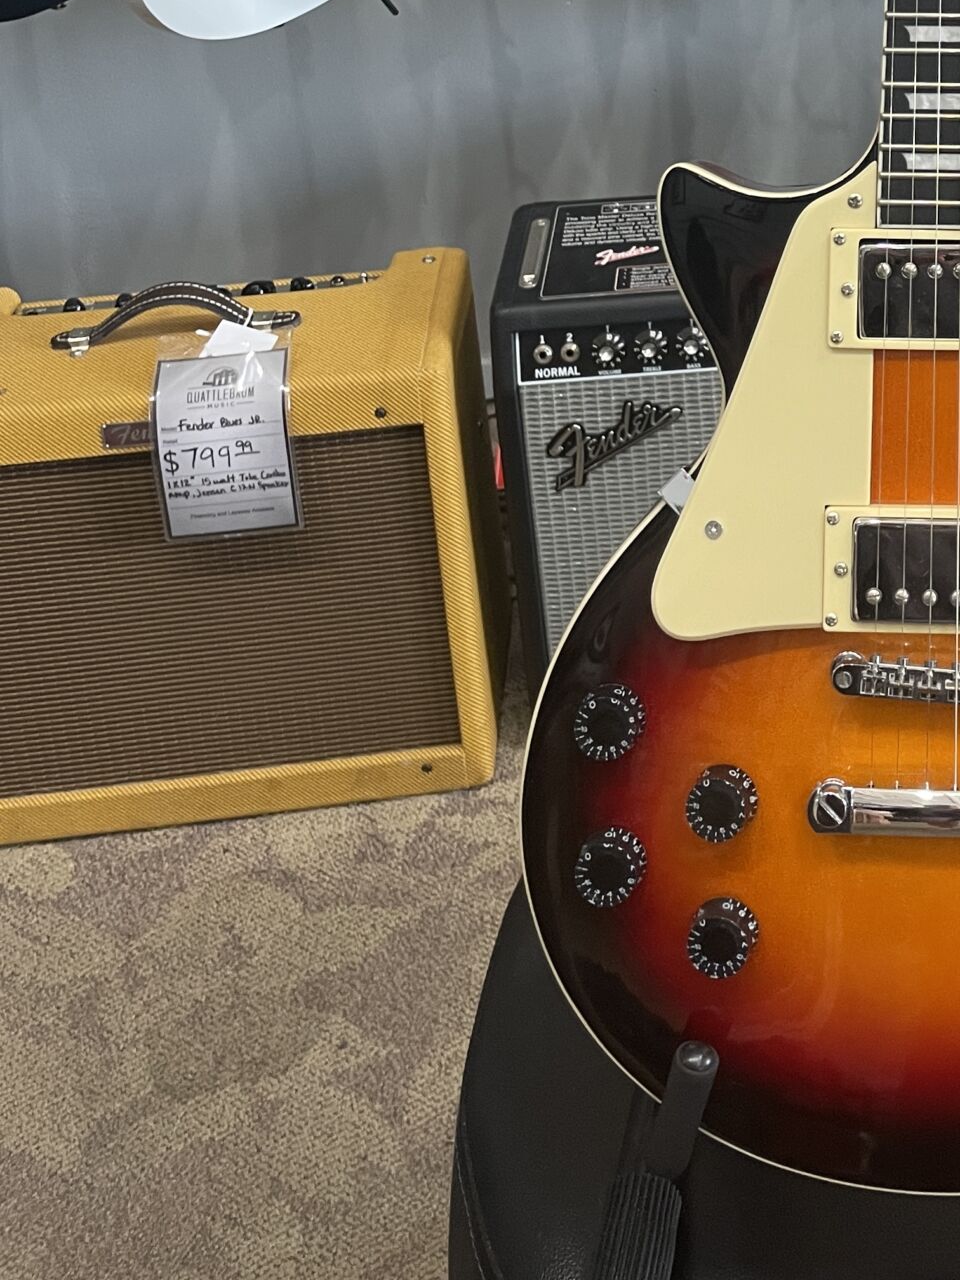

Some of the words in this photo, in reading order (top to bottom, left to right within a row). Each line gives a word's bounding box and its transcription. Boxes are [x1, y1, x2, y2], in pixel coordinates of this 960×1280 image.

[594, 245, 661, 266] Fender
[534, 366, 581, 379] NORMAL
[186, 387, 256, 404] QUATTLEBAUM
[178, 418, 215, 432] Fender
[547, 399, 683, 491] Fender
